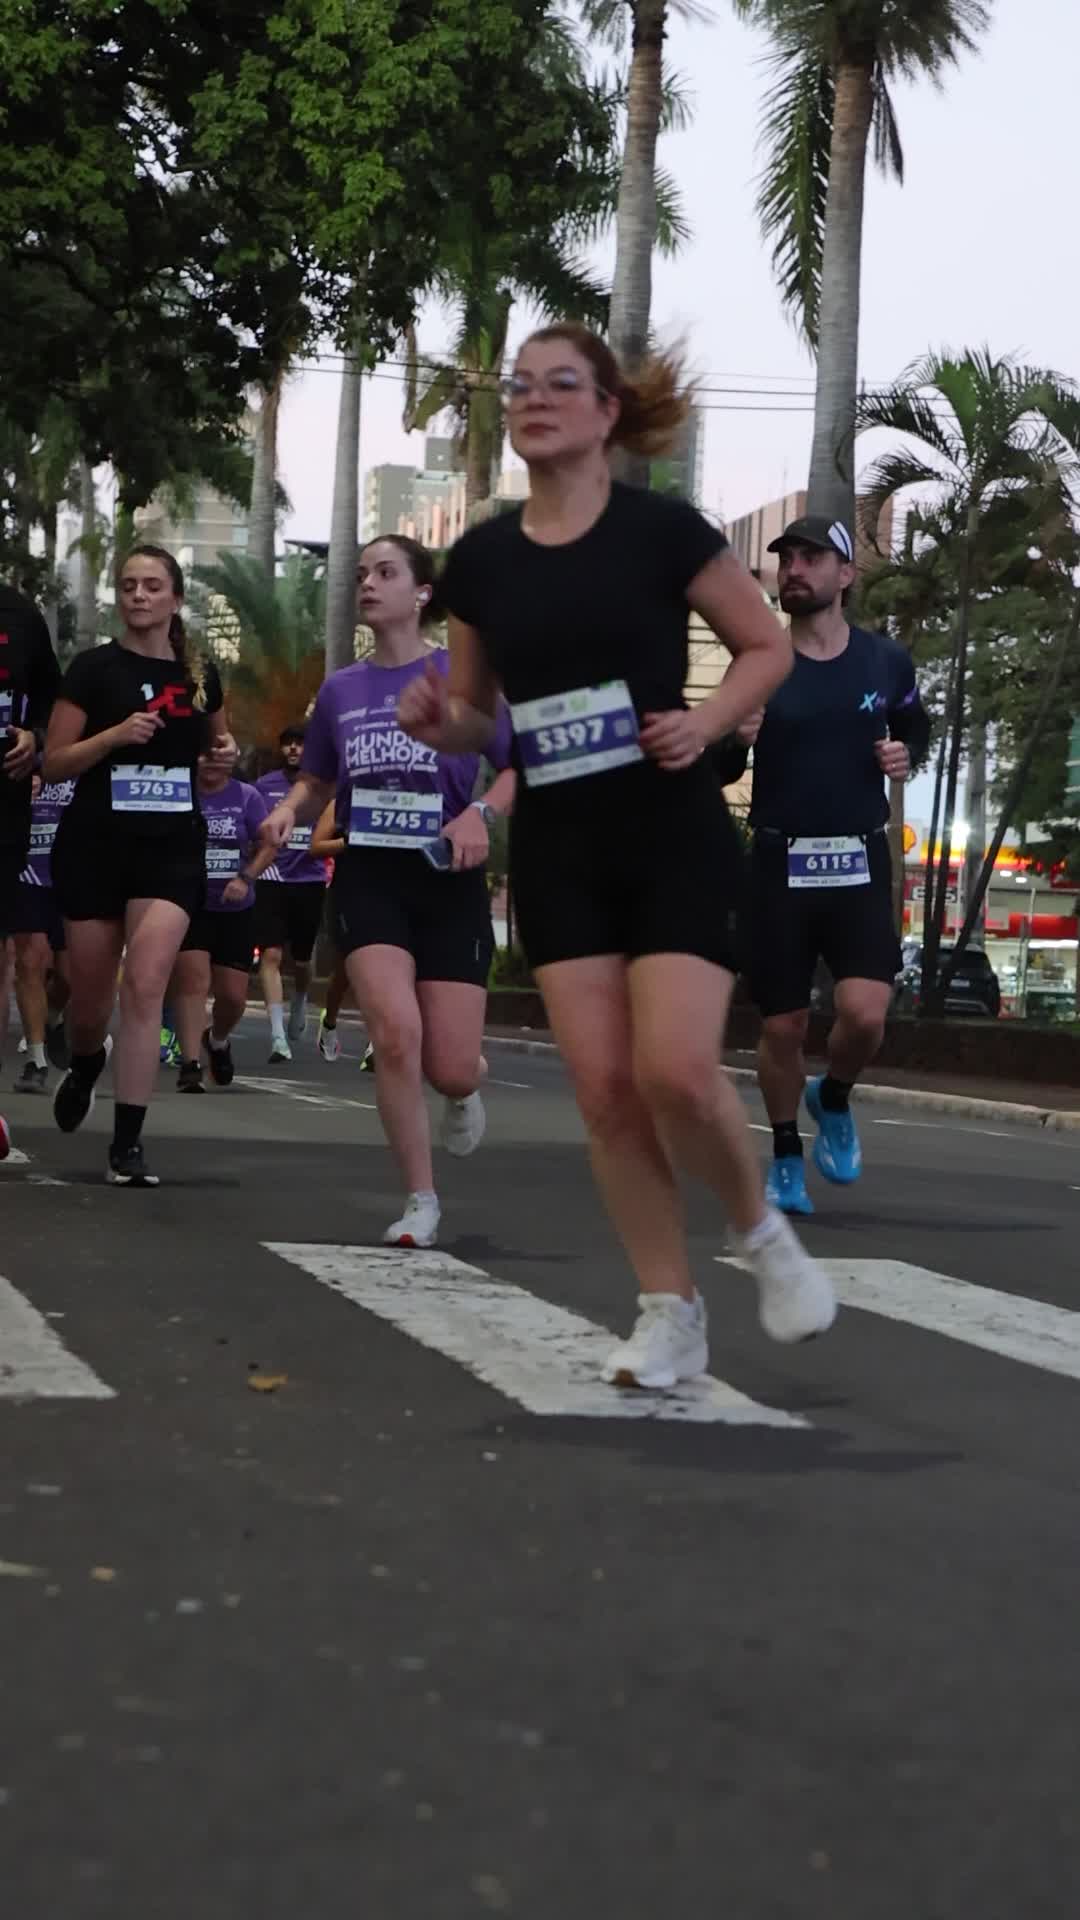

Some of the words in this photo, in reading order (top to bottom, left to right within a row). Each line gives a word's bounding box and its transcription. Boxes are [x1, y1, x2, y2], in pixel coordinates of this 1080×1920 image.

[535, 717, 605, 755] 5397
[129, 781, 175, 797] 5763
[371, 810, 421, 829] 5745
[806, 854, 852, 871] 6115
